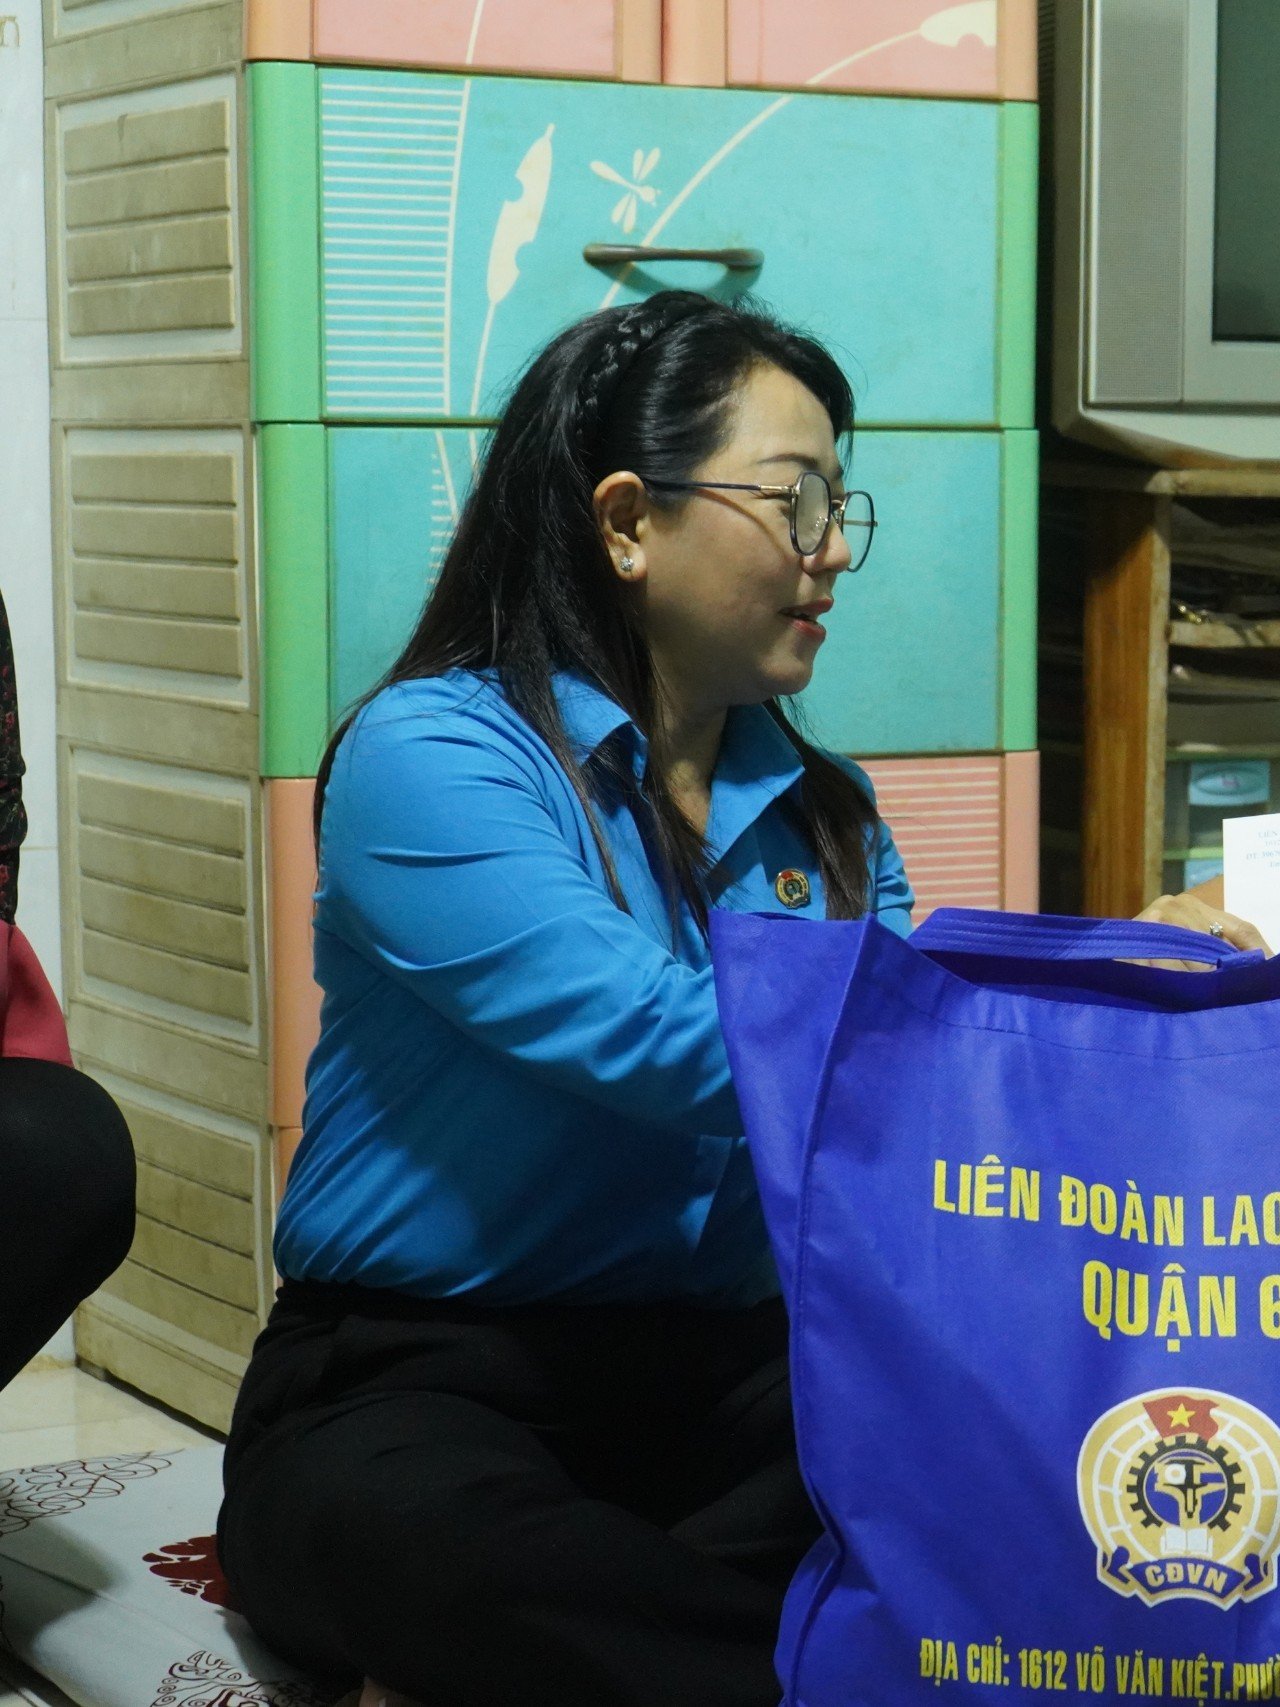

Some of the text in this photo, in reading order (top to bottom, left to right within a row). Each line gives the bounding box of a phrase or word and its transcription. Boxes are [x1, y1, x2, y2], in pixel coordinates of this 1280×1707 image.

[933, 1154, 1040, 1222] LIÊN
[1058, 1174, 1184, 1247] ĐOÀN
[1082, 1260, 1237, 1352] QUẬN
[920, 1637, 959, 1686] ĐỊA
[967, 1636, 1010, 1686] CHỈ:
[1018, 1648, 1068, 1690] 1612
[1076, 1645, 1106, 1693] VÕ
[1115, 1649, 1164, 1697] VĂN
